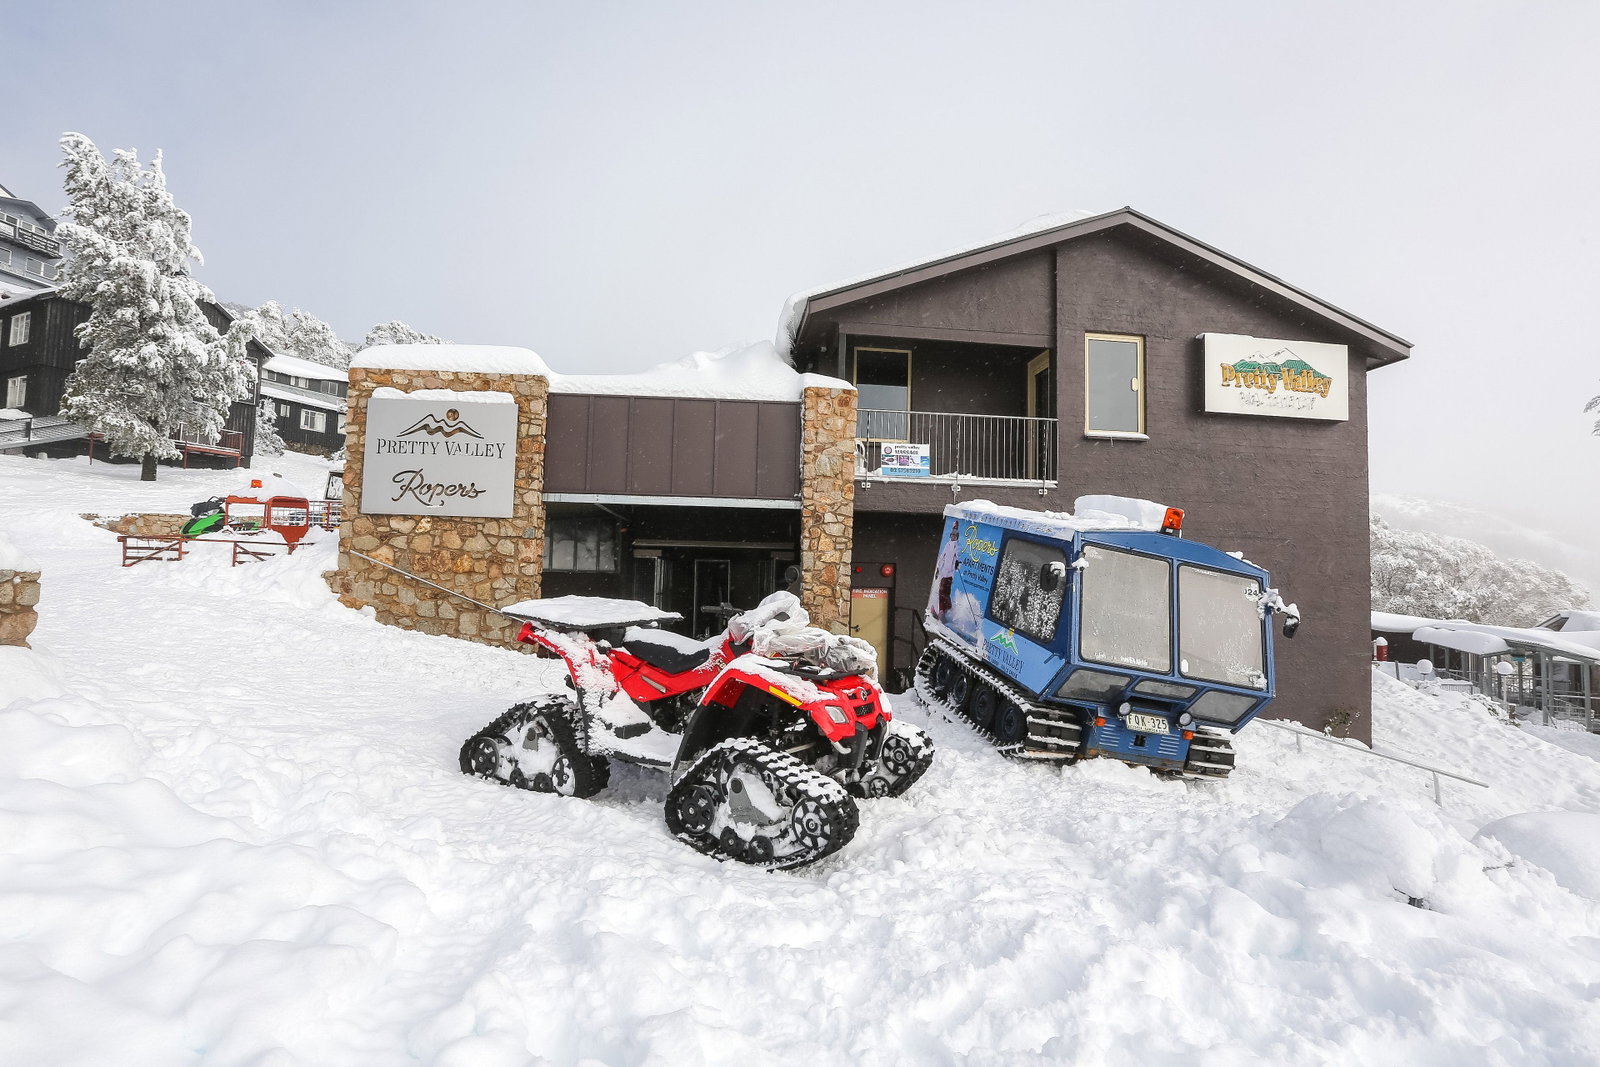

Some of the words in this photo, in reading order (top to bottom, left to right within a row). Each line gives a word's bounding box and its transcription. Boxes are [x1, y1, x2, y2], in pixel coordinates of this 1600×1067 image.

[1220, 362, 1278, 394] Pretty
[1281, 367, 1332, 398] Valley
[376, 438, 440, 455] PRETTY
[445, 441, 506, 459] VALLEY
[391, 468, 486, 507] Ropers
[963, 557, 995, 574] APARTMENTS
[1000, 649, 1025, 675] VALLEY
